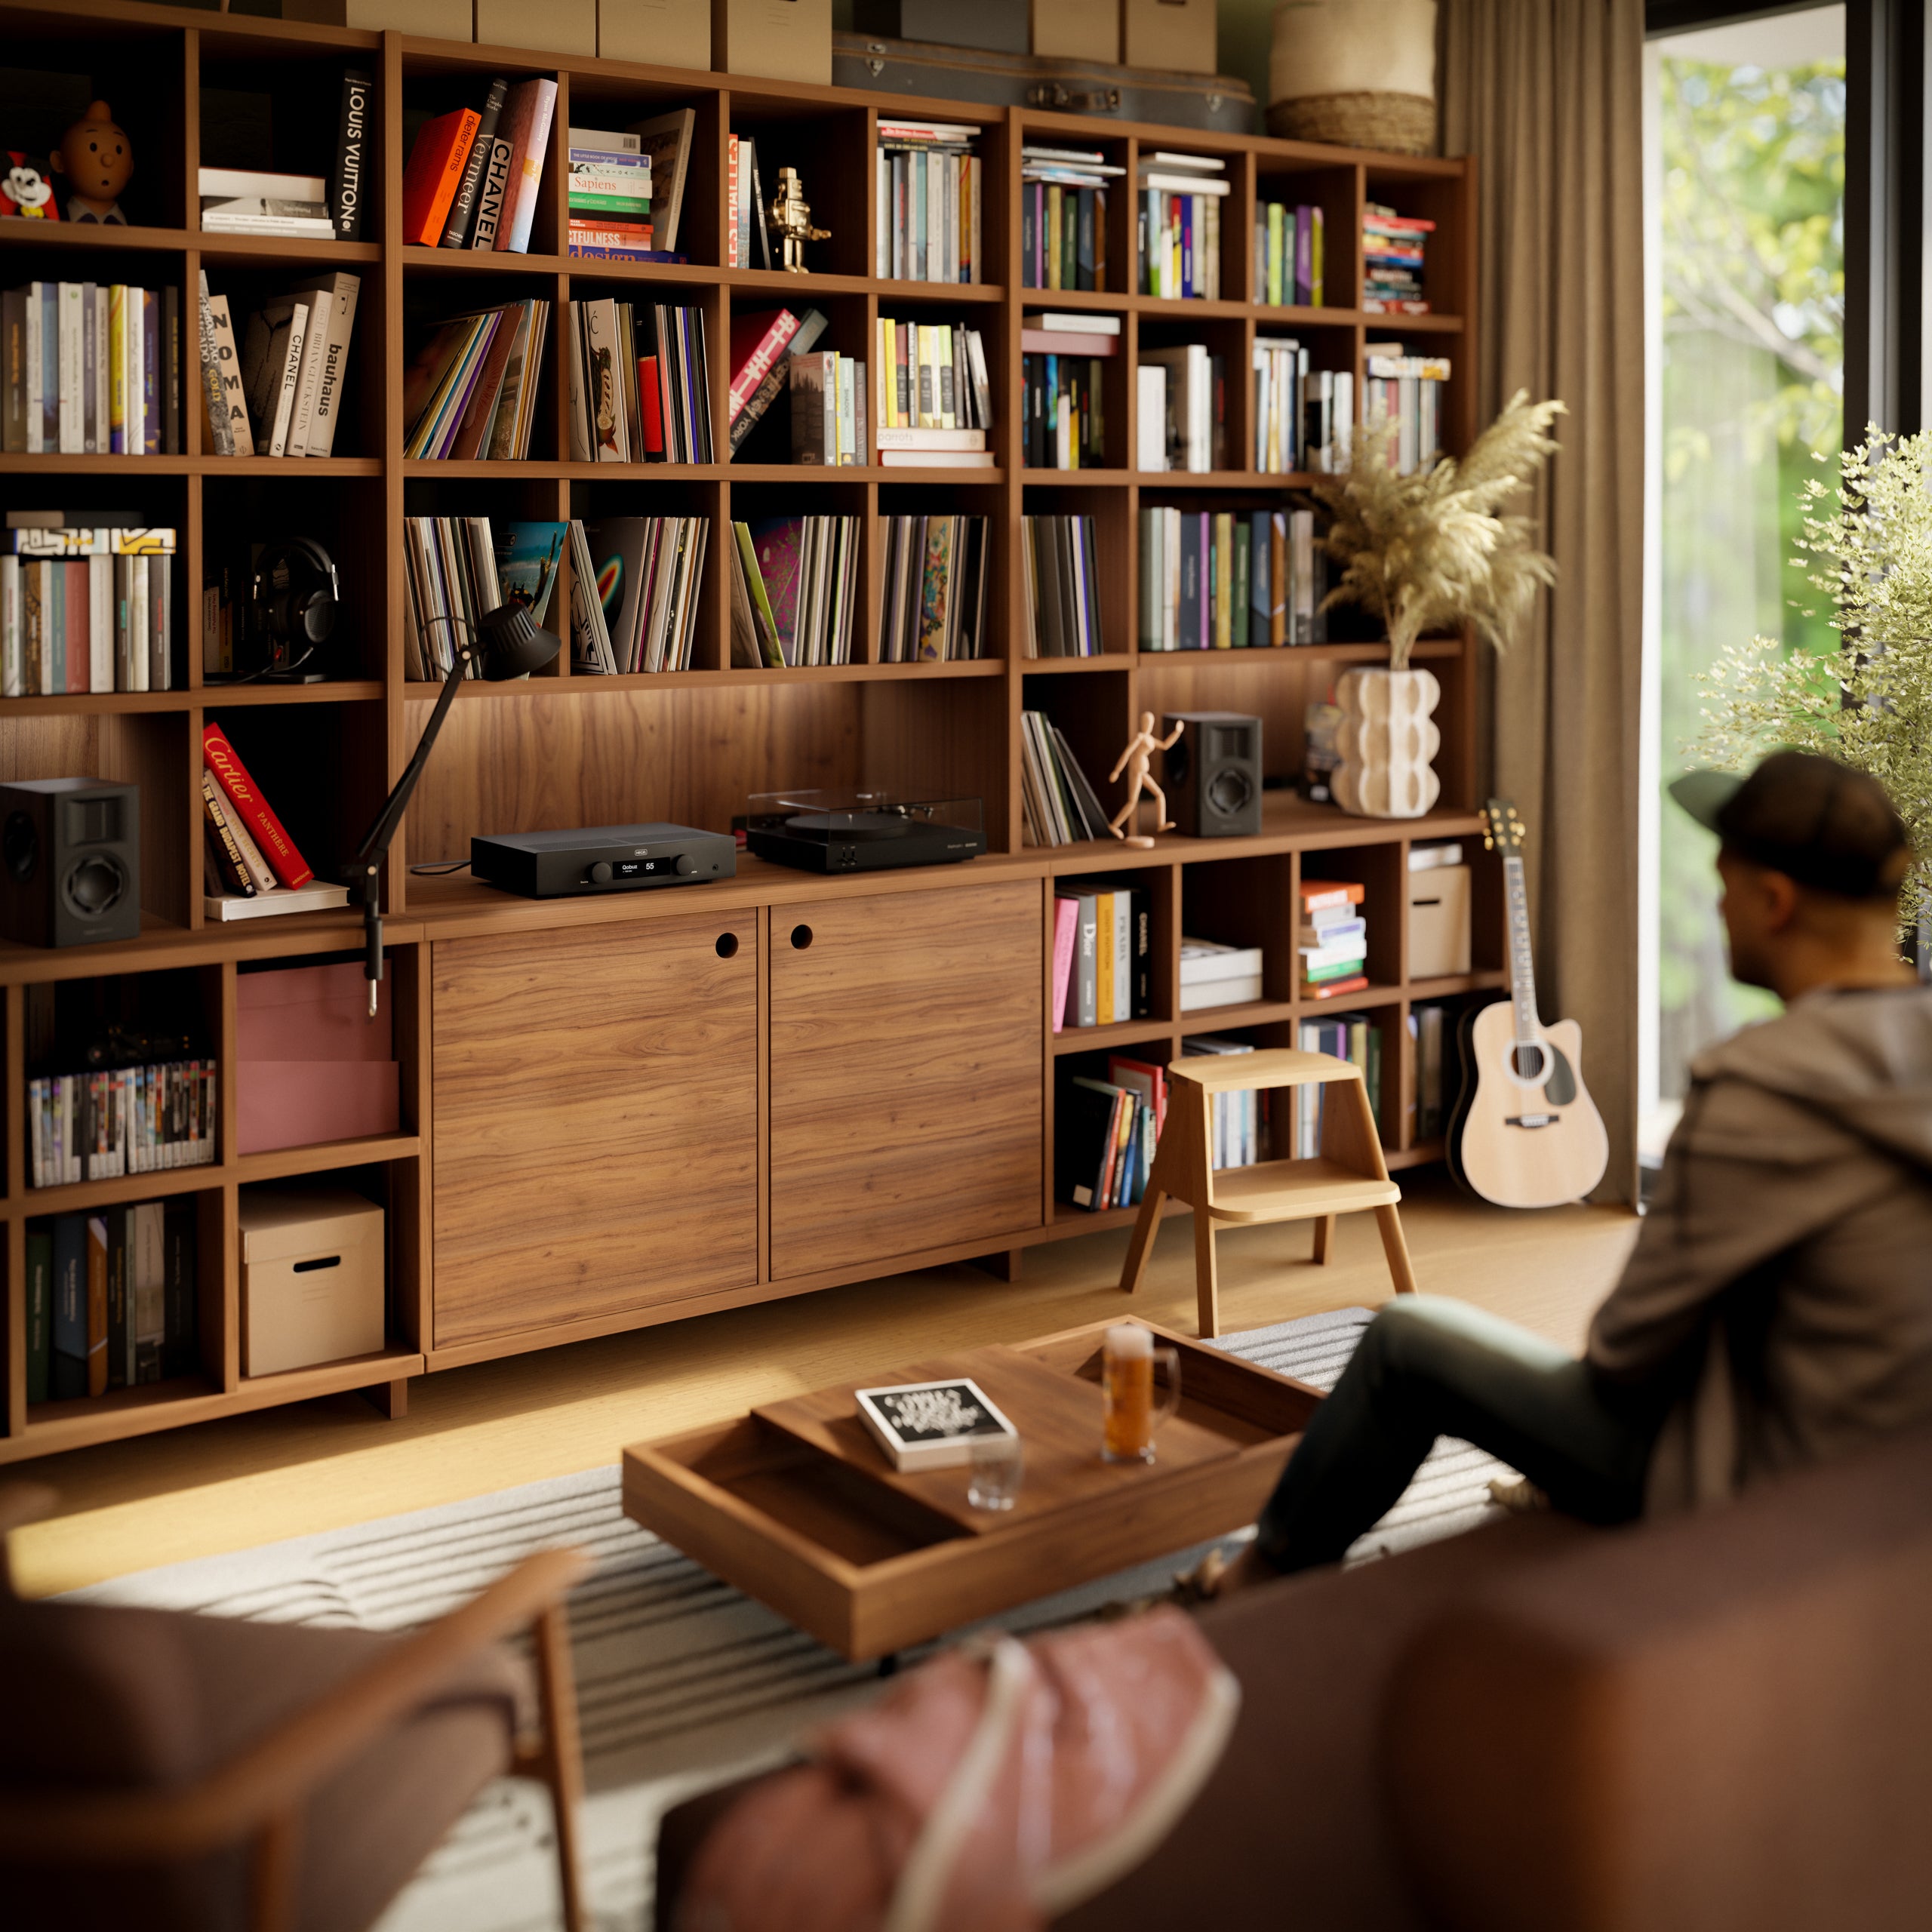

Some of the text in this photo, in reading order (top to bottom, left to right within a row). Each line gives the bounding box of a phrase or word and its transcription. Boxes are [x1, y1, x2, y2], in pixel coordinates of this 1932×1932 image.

[537, 95, 551, 142] Ryan McGinley
[341, 87, 366, 223] LOUIS VUITTON
[450, 115, 475, 172] dieter rams
[457, 134, 494, 216] Vermeer
[475, 143, 511, 248] CHANEL
[574, 176, 617, 192] Sapiens
[729, 138, 737, 267] LES HALLES
[569, 229, 620, 245] CTFULNESS
[570, 245, 636, 261] design
[212, 313, 246, 420] NOMA
[285, 334, 302, 390] CHANEL
[310, 332, 323, 365] BRIAN
[208, 368, 222, 401] GOLD
[318, 343, 342, 417] bauhaus
[731, 417, 752, 441] YORK
[203, 786, 214, 804] THE
[204, 736, 290, 858] Cartier PANTHÈRE
[208, 798, 226, 828] GRAND
[219, 826, 243, 866] BUDAPEST
[233, 863, 250, 889] HOTEL
[1083, 923, 1097, 957] Dior
[1139, 912, 1148, 956] CHANEL
